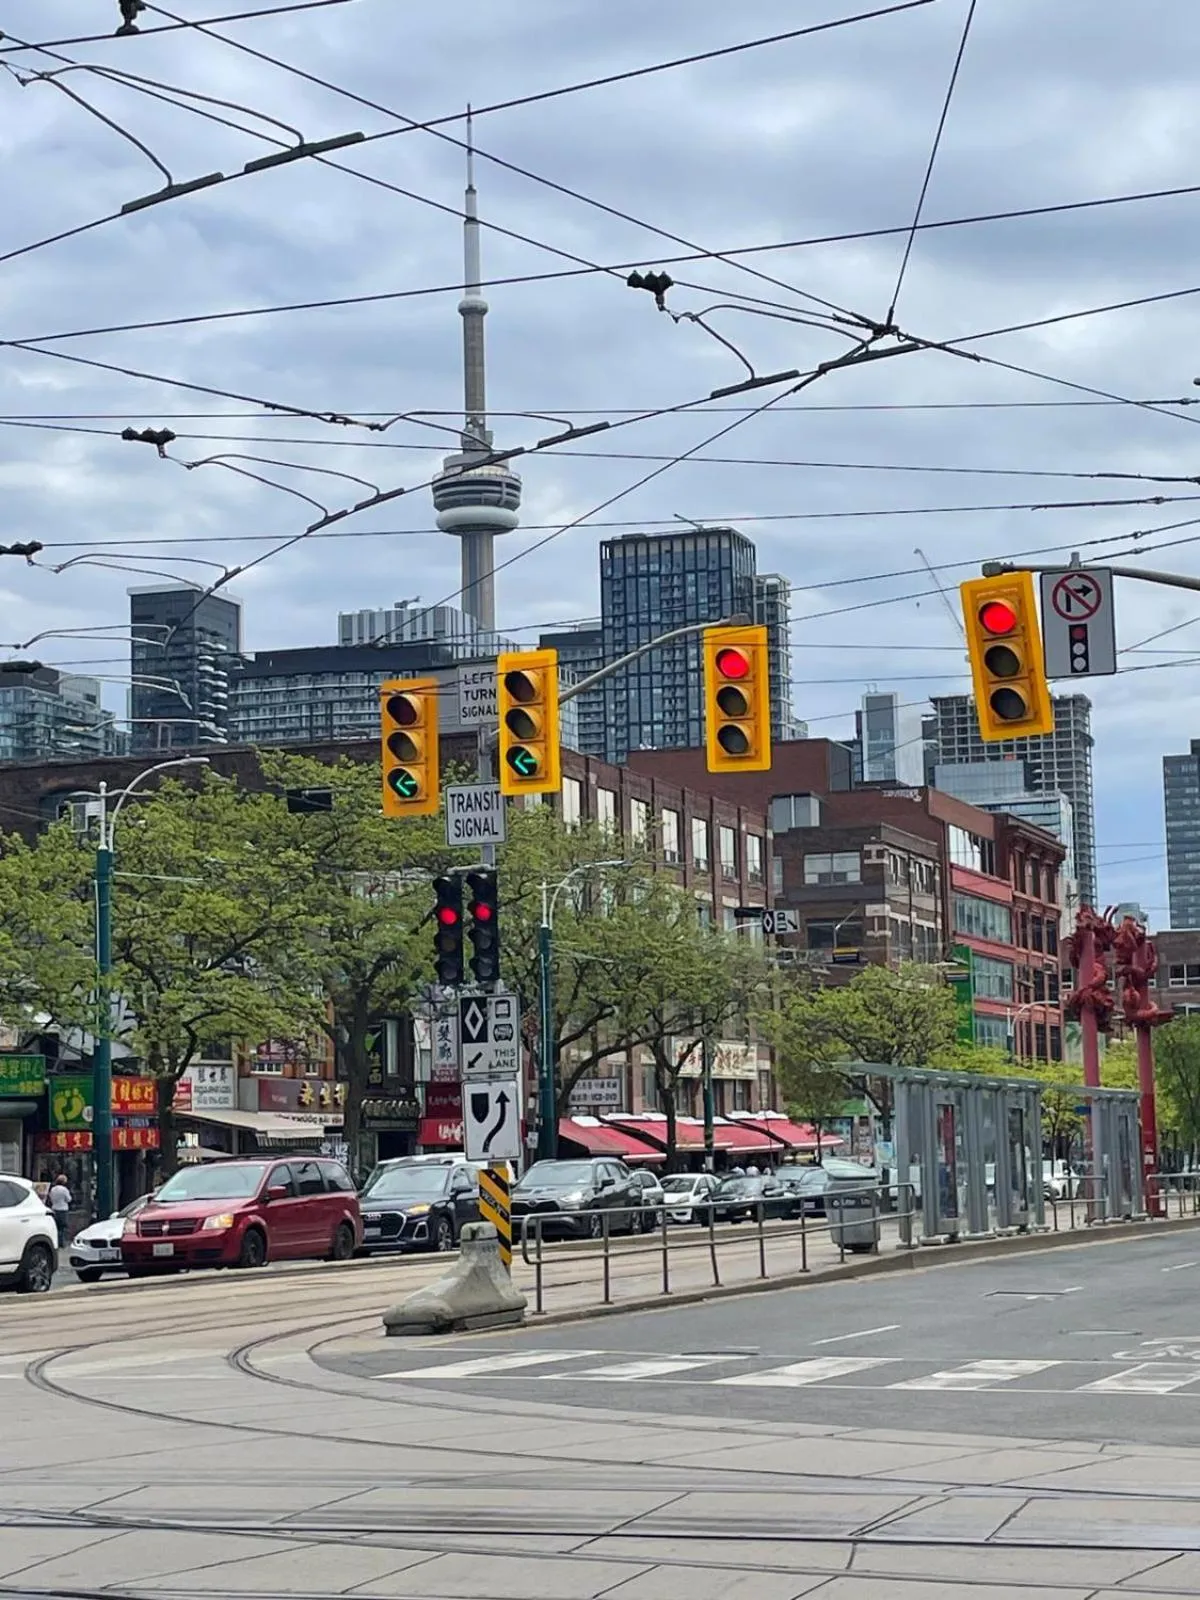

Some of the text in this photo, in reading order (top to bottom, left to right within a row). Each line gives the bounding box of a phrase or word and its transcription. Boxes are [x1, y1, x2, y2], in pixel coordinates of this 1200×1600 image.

[464, 672, 494, 685] LEFT
[464, 688, 497, 701] TURN
[462, 705, 499, 718] SIGNAL
[449, 791, 500, 814] TRANSIT
[454, 818, 499, 838] SIGNAL
[494, 1048, 516, 1058] THIS
[489, 1058, 515, 1069] LANE
